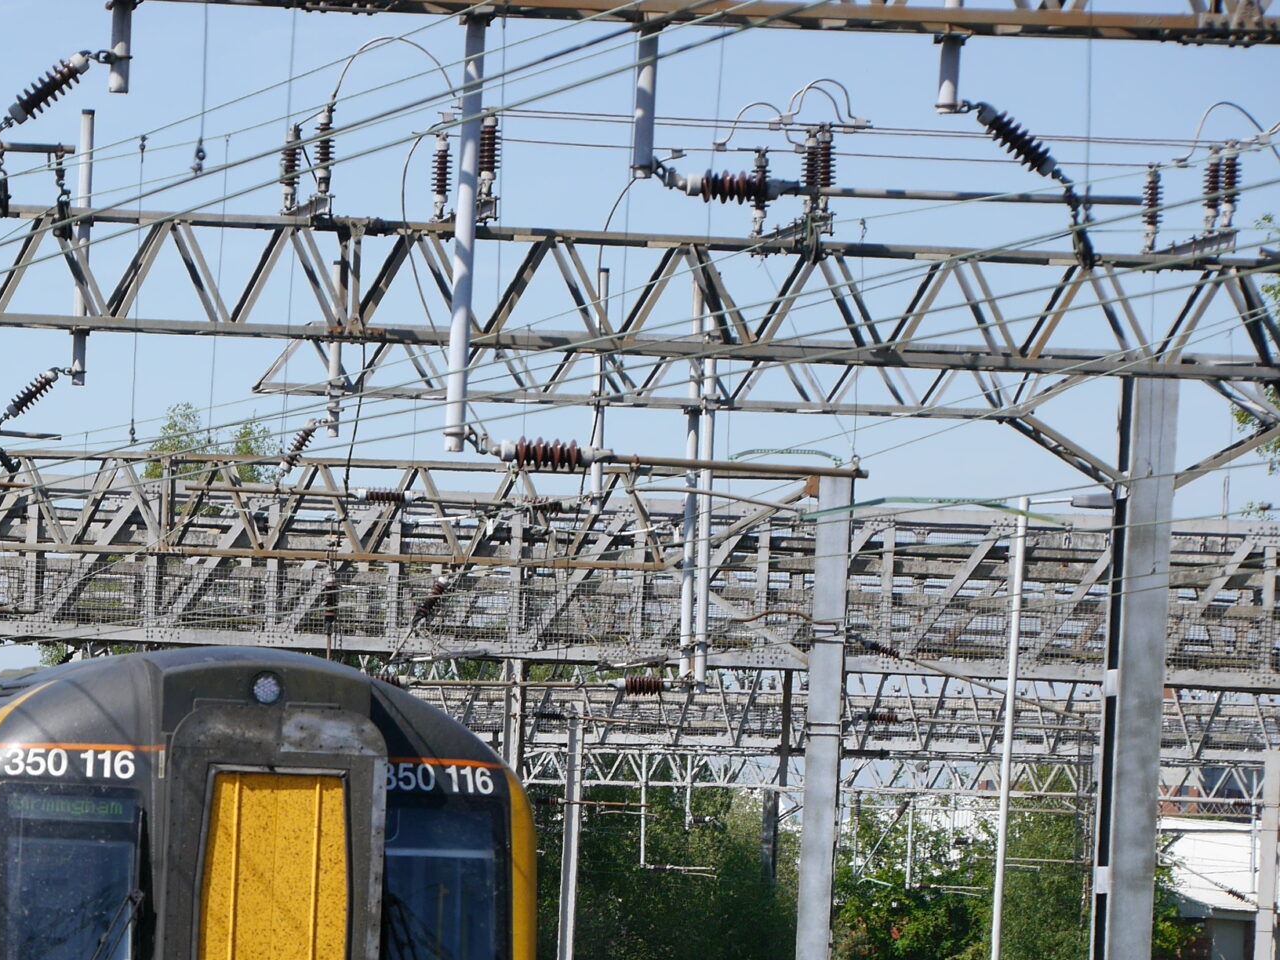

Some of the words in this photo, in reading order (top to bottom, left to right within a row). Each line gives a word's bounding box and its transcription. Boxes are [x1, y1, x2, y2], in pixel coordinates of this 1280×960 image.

[4, 748, 68, 776] 350
[80, 749, 135, 779] 116
[445, 764, 494, 795] 116
